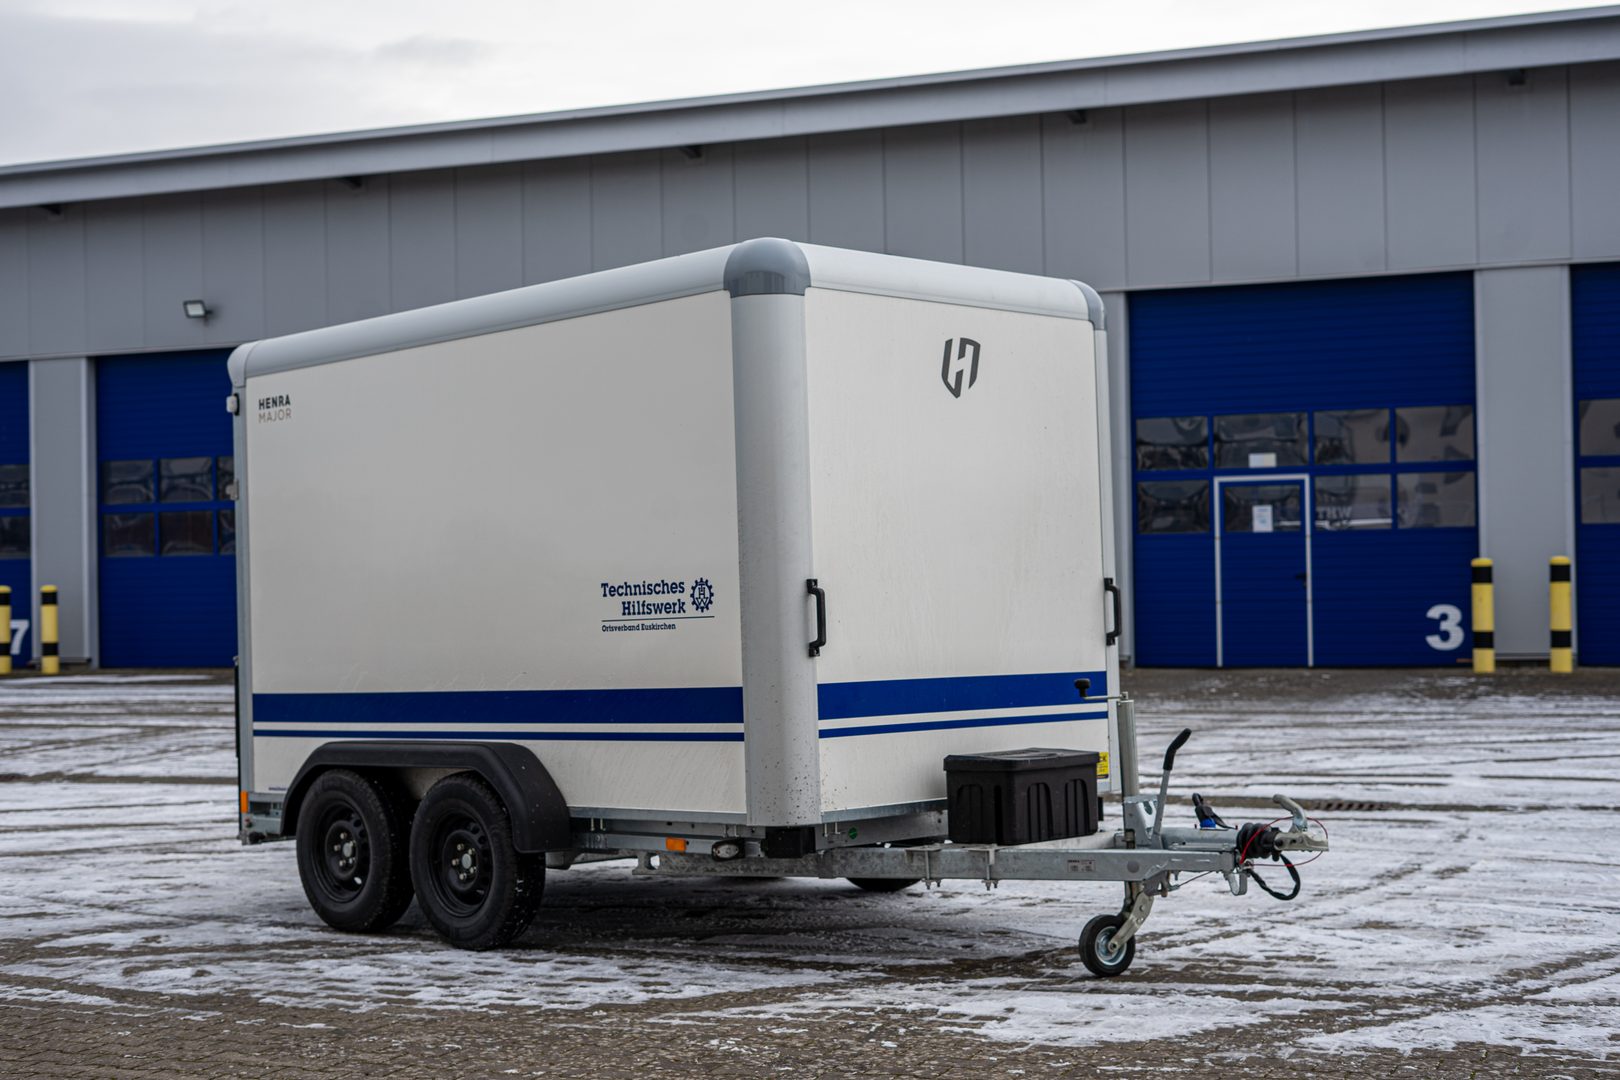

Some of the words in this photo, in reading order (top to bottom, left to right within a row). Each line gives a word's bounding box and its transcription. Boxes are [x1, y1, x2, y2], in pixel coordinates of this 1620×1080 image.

[258, 394, 291, 410] HENRA
[258, 408, 292, 424] MAJOR
[601, 580, 685, 597] Technisches
[622, 599, 686, 616] Hilfswerk
[602, 624, 640, 632] Ortsverband
[1425, 604, 1464, 651] 3
[10, 619, 30, 655] 7
